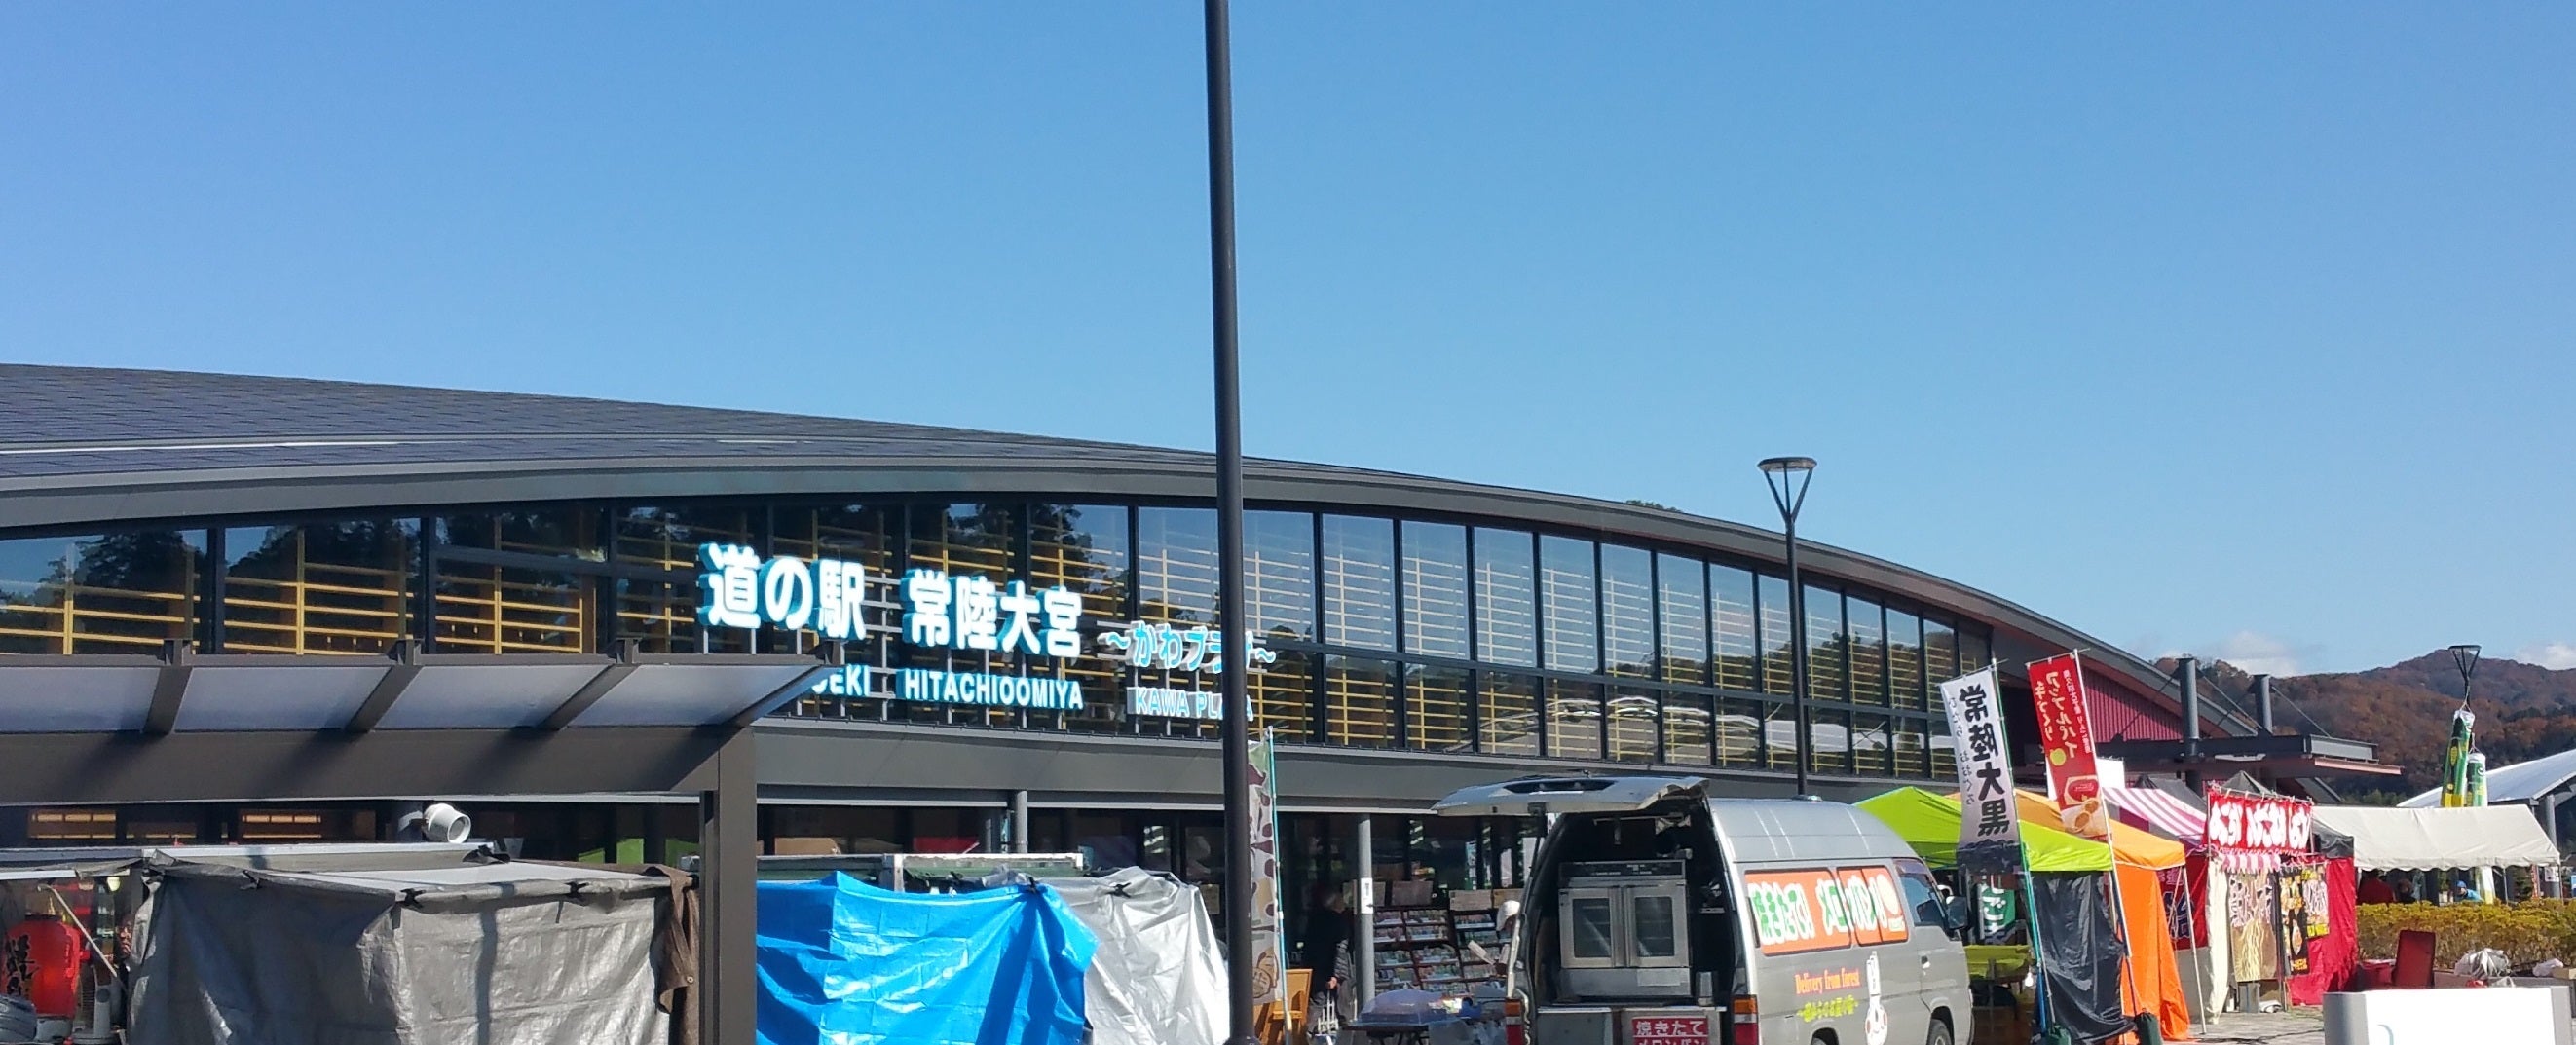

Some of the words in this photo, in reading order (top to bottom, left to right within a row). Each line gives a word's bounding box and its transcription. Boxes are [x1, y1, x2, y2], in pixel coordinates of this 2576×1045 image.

[701, 542, 867, 641] 道の駅
[904, 569, 1083, 658] 常陸大宮
[903, 667, 1084, 709] HITACHIOOMIYA
[1136, 686, 1191, 717] KAWA
[1195, 690, 1254, 722] PLA
[1795, 972, 1824, 994] Delivery
[1824, 969, 1841, 989] from
[1842, 967, 1861, 988] forest
[1636, 1020, 1704, 1036] 焼きたて
